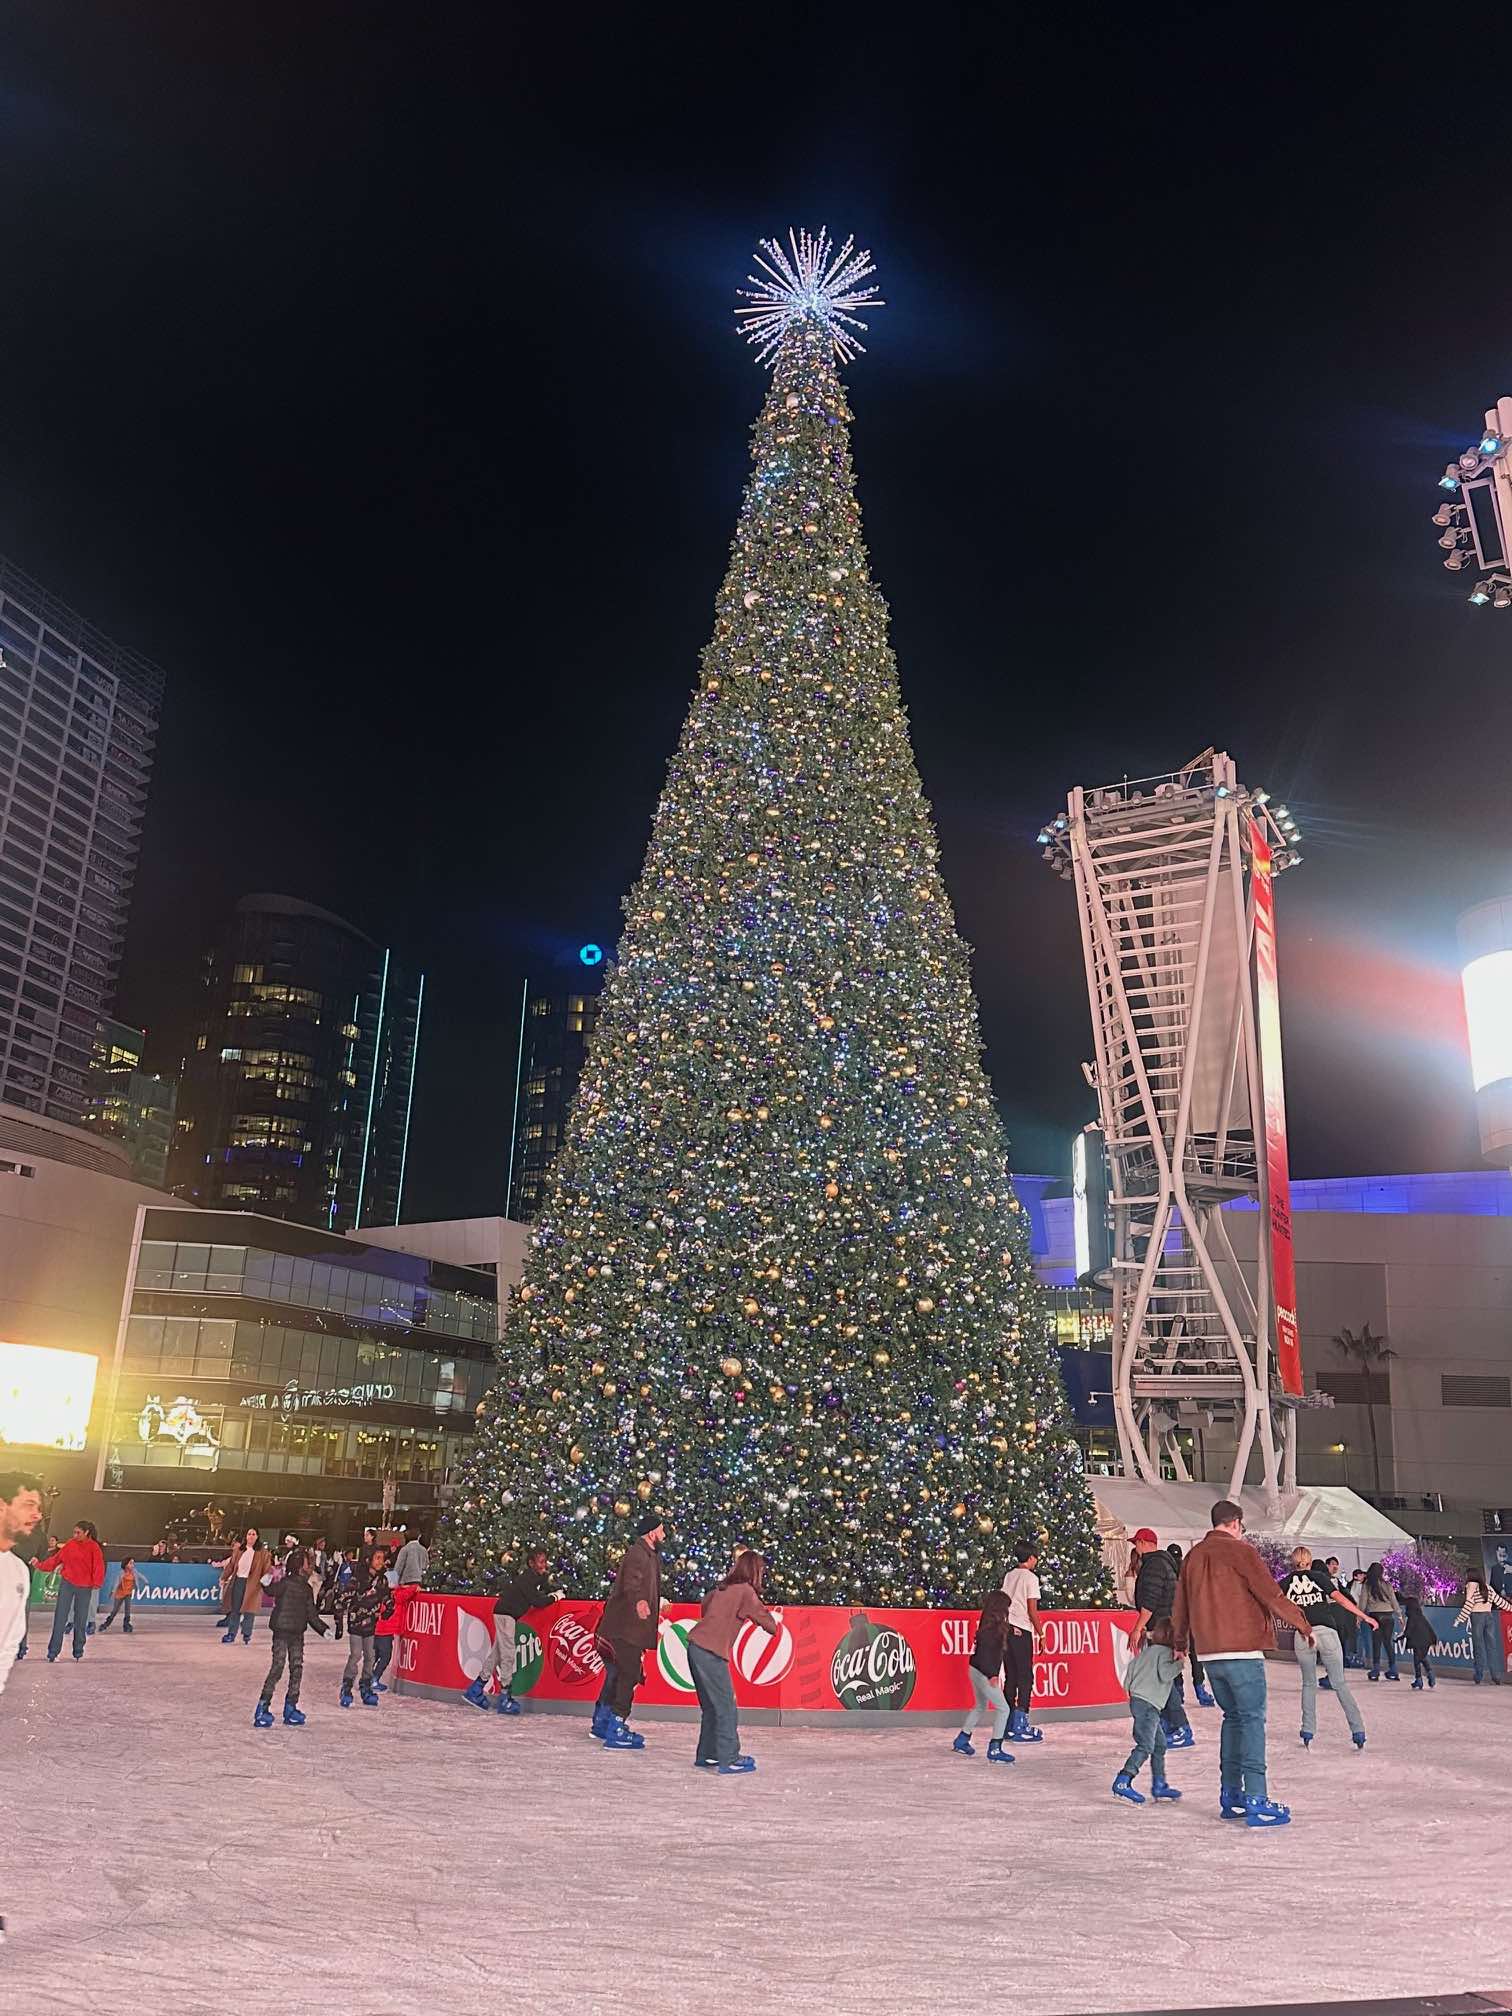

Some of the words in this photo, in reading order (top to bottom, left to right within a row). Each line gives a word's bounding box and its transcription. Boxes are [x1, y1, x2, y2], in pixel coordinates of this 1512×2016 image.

[406, 1600, 445, 1635] OLIDAY
[512, 1632, 543, 1674] rite
[830, 1630, 916, 1698] Coca-Cola
[856, 1691, 875, 1704] Real
[875, 1681, 904, 1699] Magic
